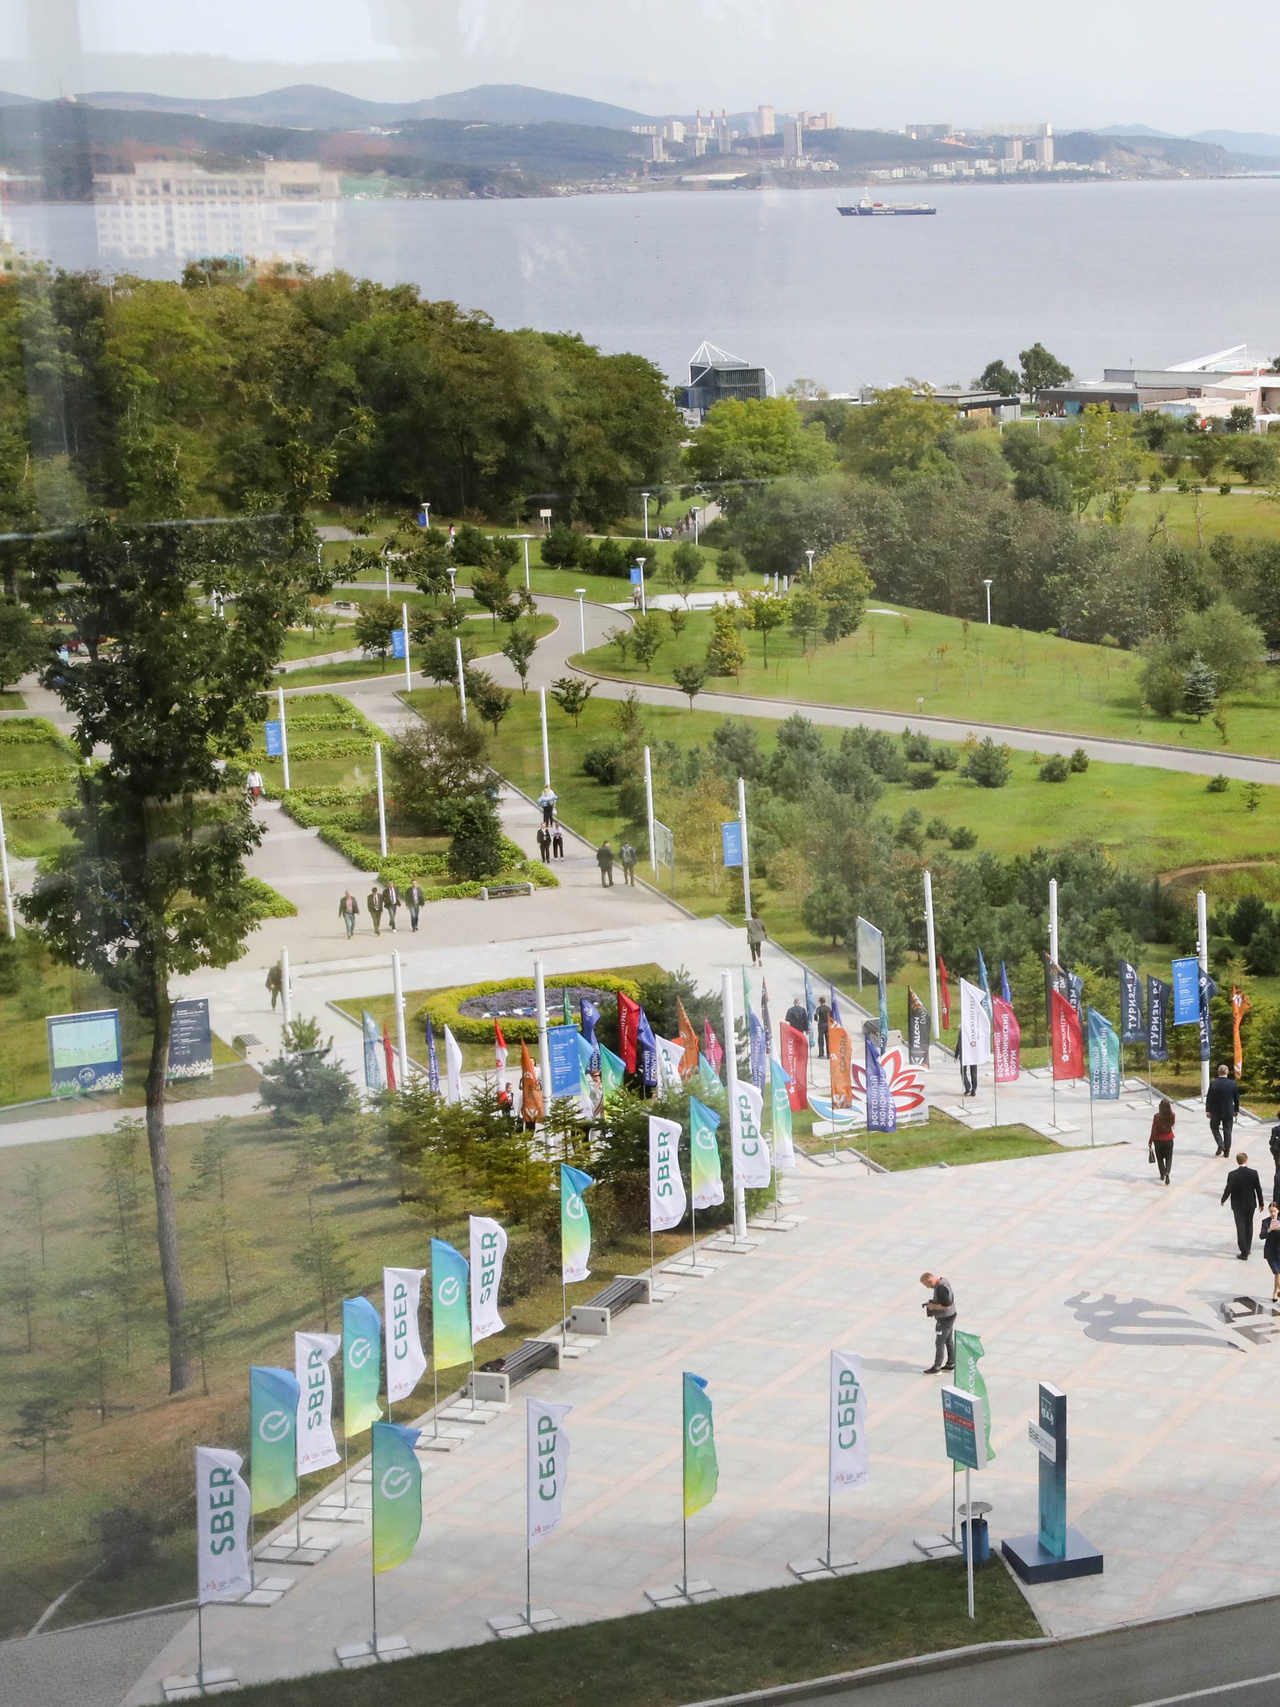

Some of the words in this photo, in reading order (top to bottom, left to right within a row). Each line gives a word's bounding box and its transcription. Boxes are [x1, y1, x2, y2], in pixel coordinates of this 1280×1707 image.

[1092, 1046, 1100, 1095] ВОСТОЧНЫЙ
[1100, 1027, 1108, 1095] ЭКОНОМИЧЕСКИЙ
[1109, 1066, 1117, 1095] ФОРУМ
[870, 1076, 878, 1125] ВОСТОЧНЫЙ
[656, 1132, 673, 1196] SBER
[479, 1232, 498, 1304] SBER
[393, 1283, 407, 1360] СБЕР
[307, 1349, 325, 1430] SBER
[838, 1370, 858, 1449] СБЕР
[537, 1415, 558, 1500] СБЕР
[210, 1468, 236, 1555] SBER
